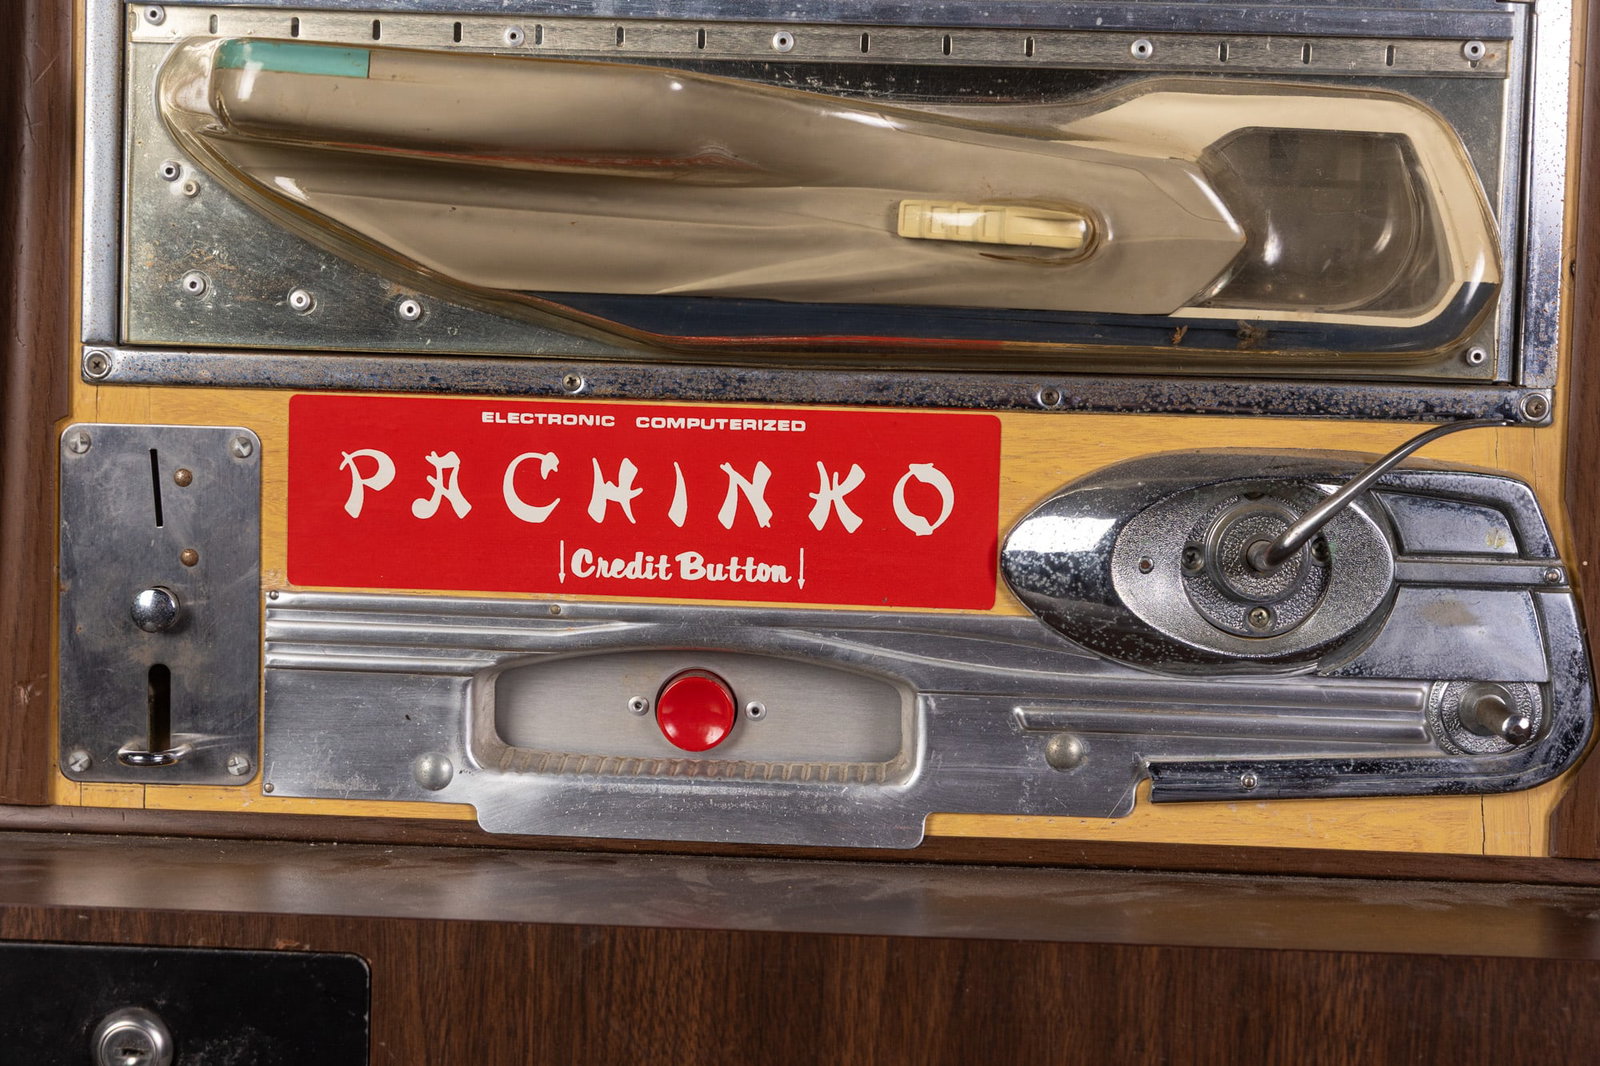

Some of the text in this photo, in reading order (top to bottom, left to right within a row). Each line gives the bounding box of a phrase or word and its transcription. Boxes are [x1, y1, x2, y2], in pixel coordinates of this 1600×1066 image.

[481, 411, 807, 433] ELECTRONIC COMPUTERIZED
[339, 448, 956, 537] PACHINKO
[570, 547, 793, 585] Credit Button
